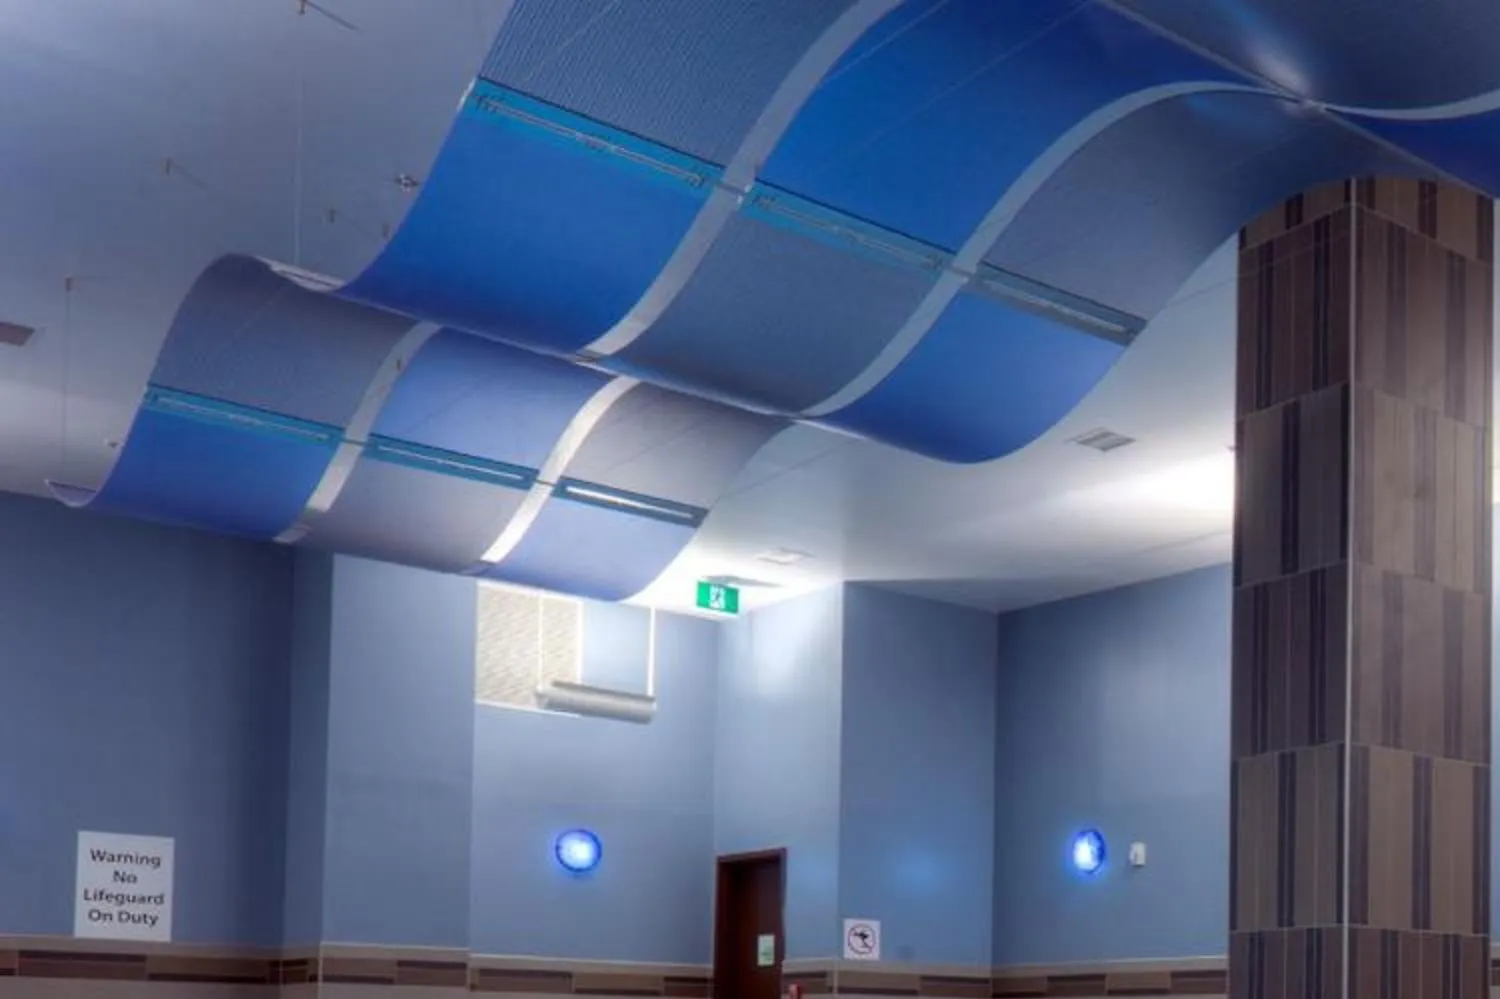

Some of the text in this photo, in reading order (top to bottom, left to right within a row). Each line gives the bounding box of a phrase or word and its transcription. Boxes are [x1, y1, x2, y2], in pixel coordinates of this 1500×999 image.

[90, 848, 161, 869] Warning
[113, 869, 138, 884] No
[83, 889, 165, 906] Lifeguard
[88, 909, 159, 928] On Duty
